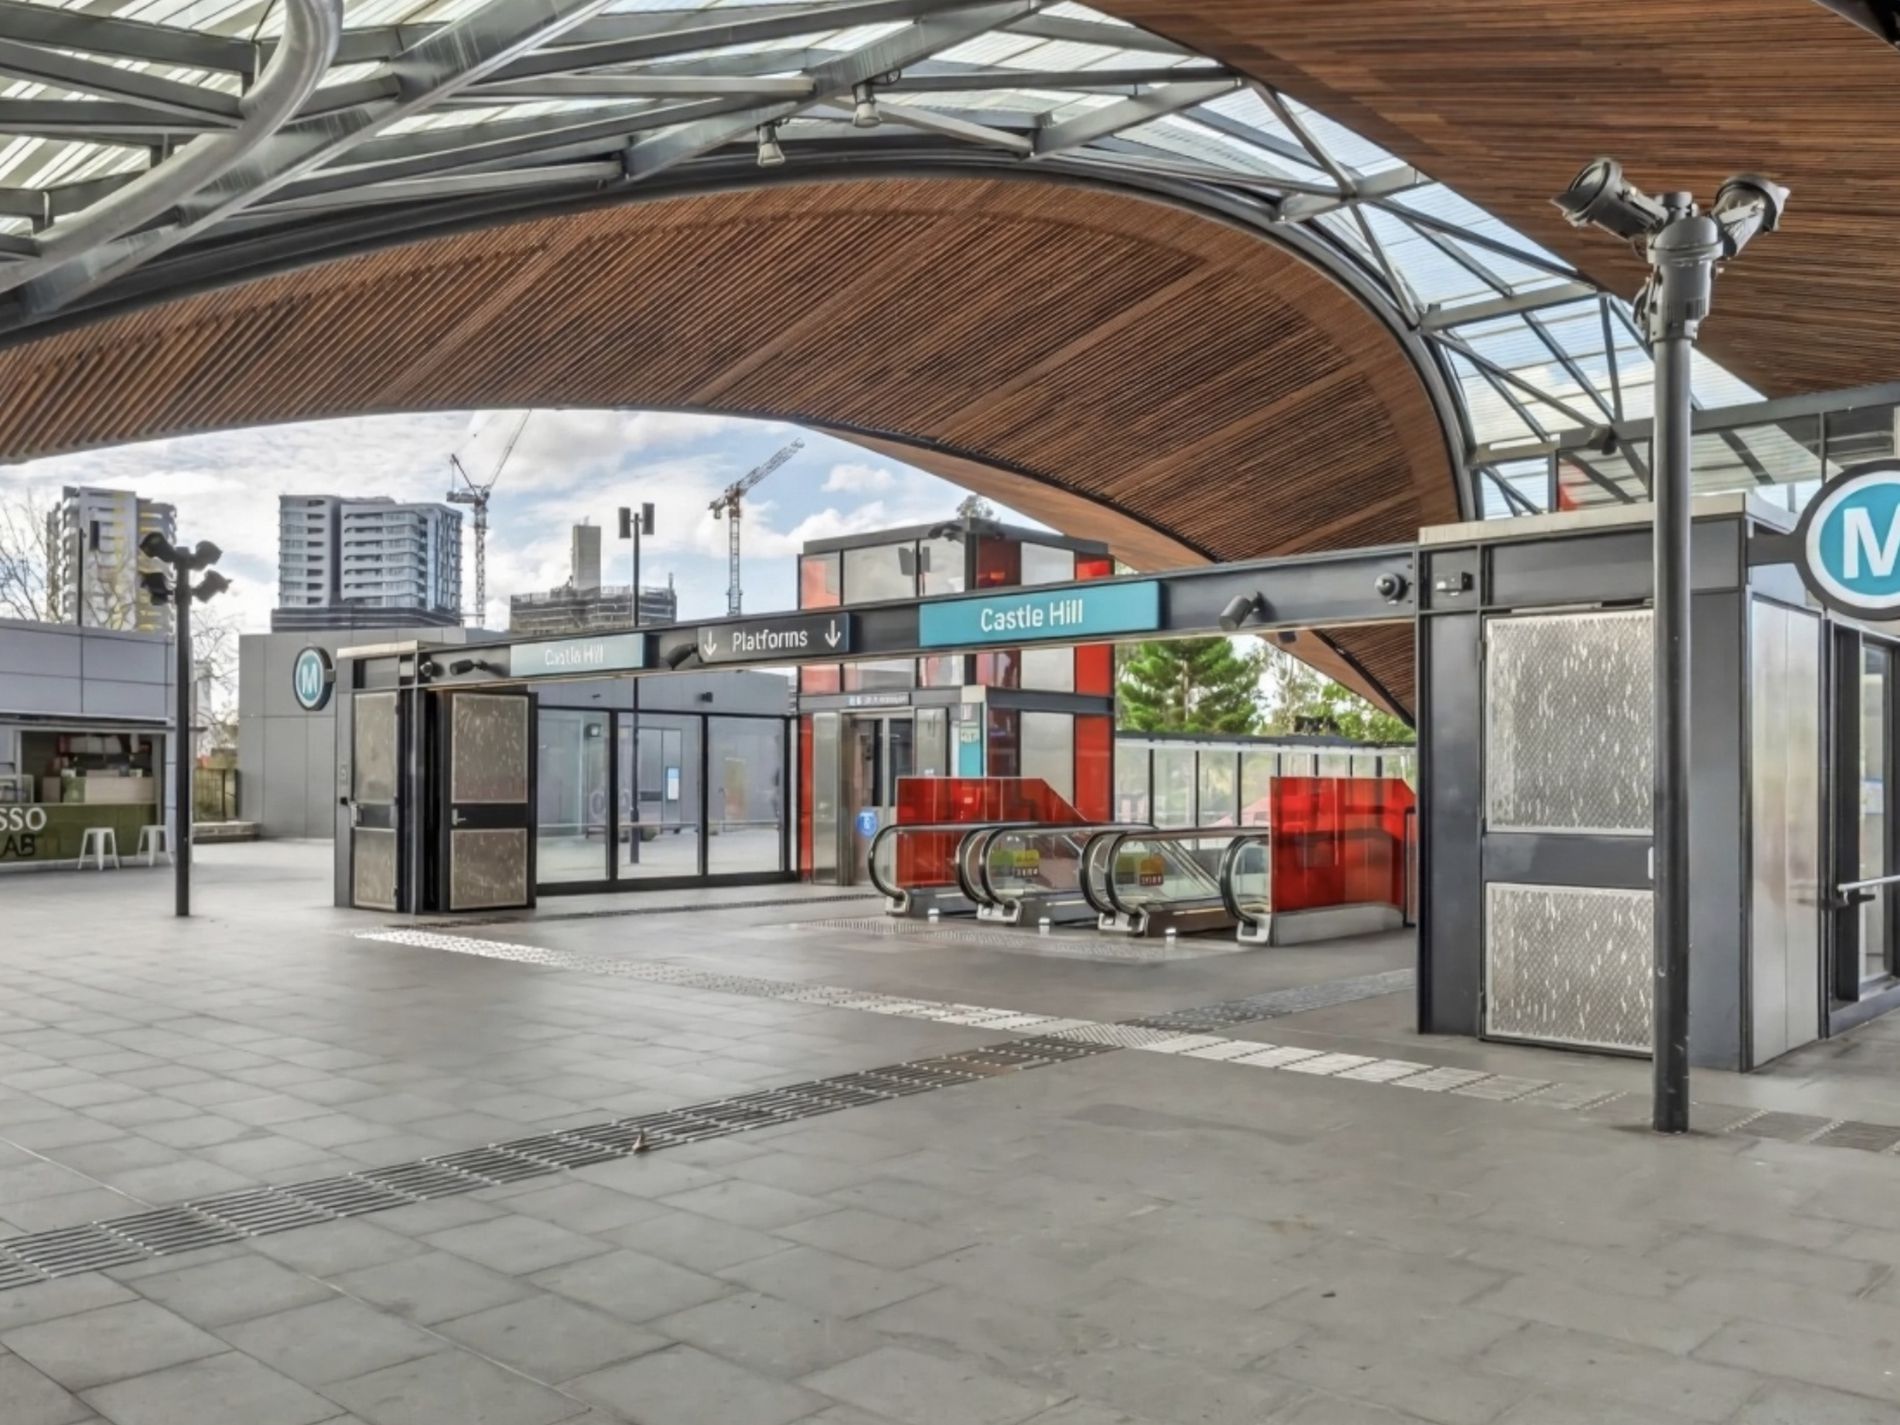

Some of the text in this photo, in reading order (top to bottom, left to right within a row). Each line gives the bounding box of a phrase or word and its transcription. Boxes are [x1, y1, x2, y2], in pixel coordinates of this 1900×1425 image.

[1843, 502, 1900, 579] M
[981, 598, 1083, 632] Castle Hill
[732, 629, 808, 652] Platforms
[302, 661, 318, 694] M
